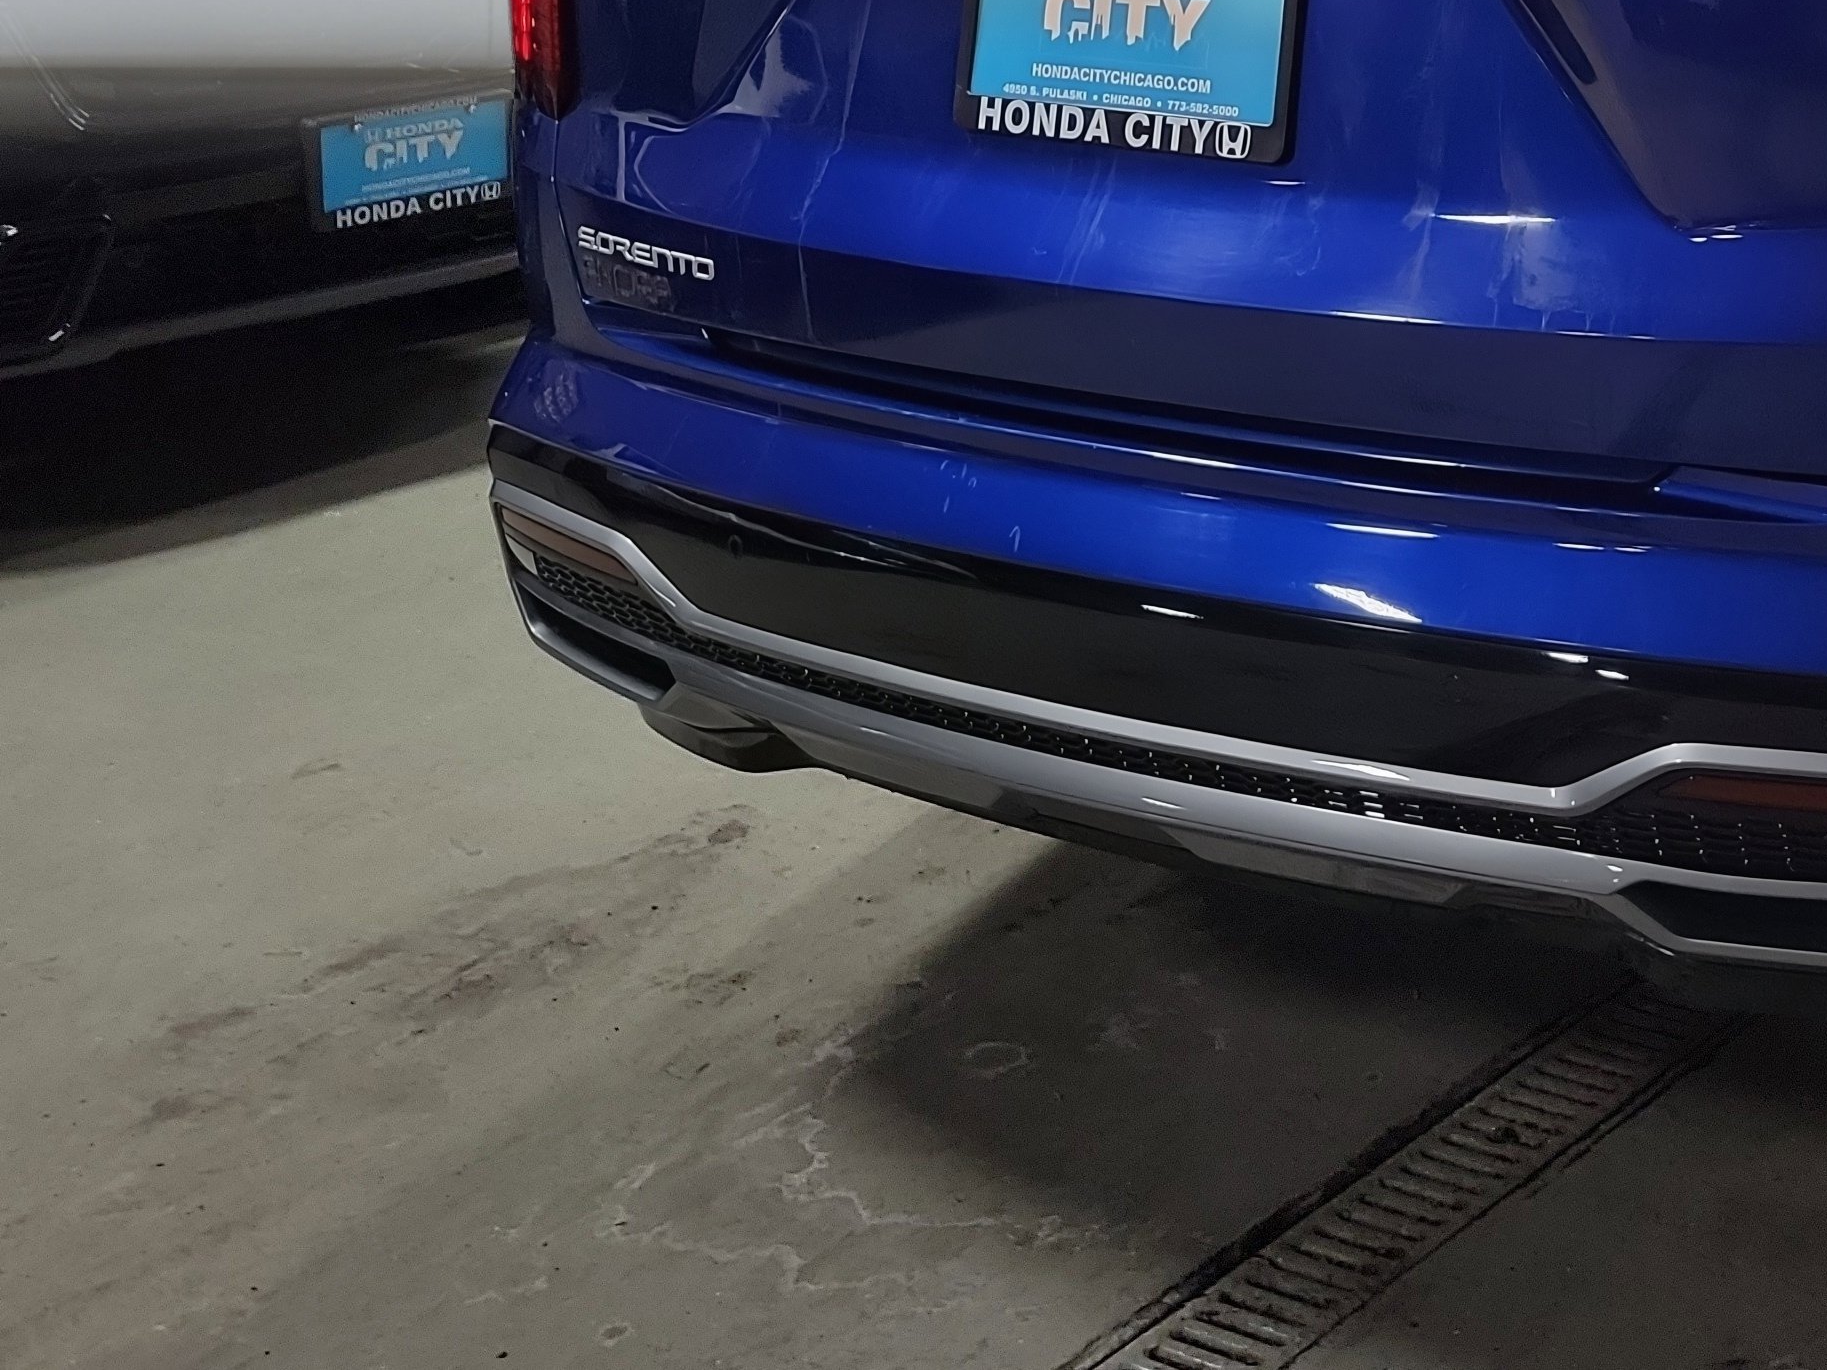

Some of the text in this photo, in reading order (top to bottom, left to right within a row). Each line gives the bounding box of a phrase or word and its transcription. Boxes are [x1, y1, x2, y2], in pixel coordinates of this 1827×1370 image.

[1002, 82, 1029, 96] 4950
[1042, 87, 1088, 102] PULASKI
[1102, 93, 1152, 108] CHICAGO
[1031, 62, 1212, 95] HONDACITYCHICAGO.COM
[384, 117, 464, 139] HONDA
[977, 96, 1110, 145] HONDA
[1124, 113, 1216, 156] CITY
[364, 129, 464, 172] CITY
[335, 196, 422, 229] HONDA
[428, 184, 480, 212] CITY
[577, 225, 715, 281] SORENTO
